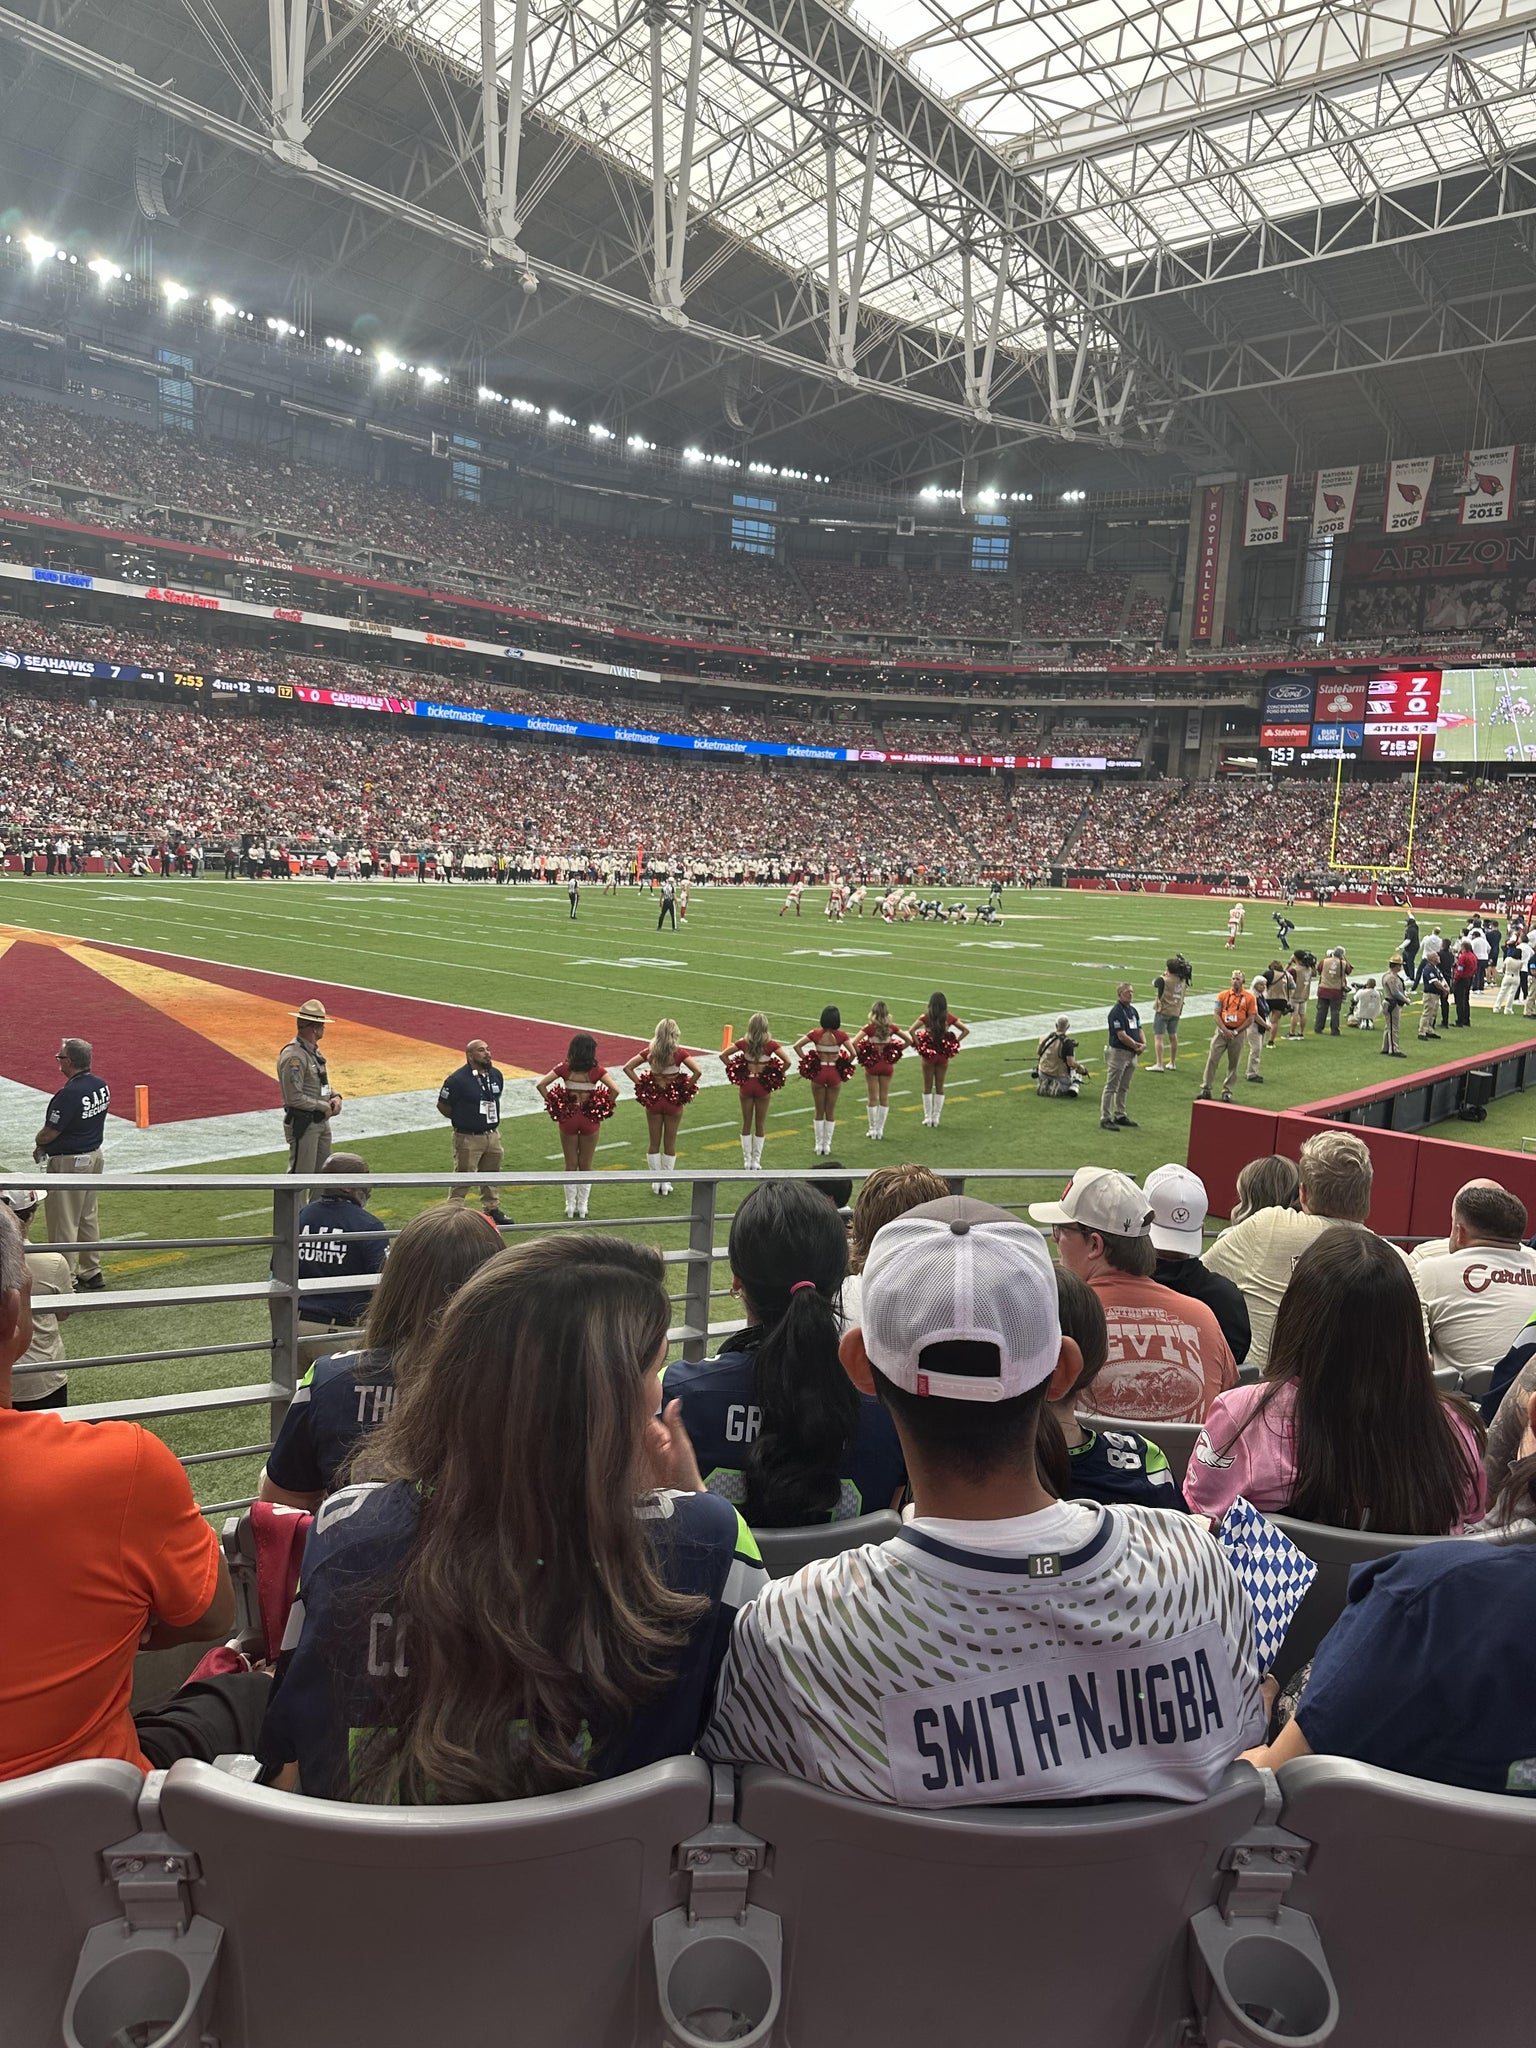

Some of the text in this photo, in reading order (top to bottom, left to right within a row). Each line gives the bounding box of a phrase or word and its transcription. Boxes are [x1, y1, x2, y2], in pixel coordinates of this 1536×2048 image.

[1489, 451, 1509, 459] WEST
[1395, 467, 1429, 476] DIVISION
[1469, 501, 1503, 509] CHAMPIONS
[1318, 516, 1345, 525] CHAMPIONS
[1468, 507, 1503, 520] 2015
[1317, 522, 1344, 534] 2008
[1249, 531, 1279, 542] 2008
[233, 554, 261, 566] LARRY
[262, 559, 293, 571] WILSON
[1200, 502, 1217, 635] FOOTBALL CLUB
[34, 570, 91, 587] BUD LIGHT
[164, 588, 220, 610] State Farm
[369, 622, 393, 634] RIVER
[547, 615, 561, 624] DICK
[600, 626, 615, 634] LANE
[1471, 652, 1516, 660] CARDINALS
[23, 655, 95, 673] SEAHAWKS
[110, 665, 121, 678] 7
[157, 671, 165, 683] 1
[609, 664, 641, 680] AVNET
[174, 673, 204, 688] 7:53
[1411, 677, 1429, 692] 7
[280, 687, 291, 696] 17
[1275, 686, 1303, 698] Ford
[330, 692, 384, 707] CARDINALS
[1408, 697, 1427, 712] 0
[427, 704, 486, 723] ticketmaster
[527, 717, 579, 735] ticketmaster
[614, 728, 661, 745] ticketmaster
[693, 738, 748, 753] ticketmaster
[786, 746, 838, 759] ticketmaster
[1379, 740, 1418, 751] 7:53
[1268, 747, 1295, 761] 7:53
[1257, 889, 1312, 899] CARDALS
[1348, 883, 1444, 895] ARIZNA CADINALS
[1035, 1557, 1055, 1576] 12
[913, 1648, 1224, 1791] SMITH-NJIGBA
